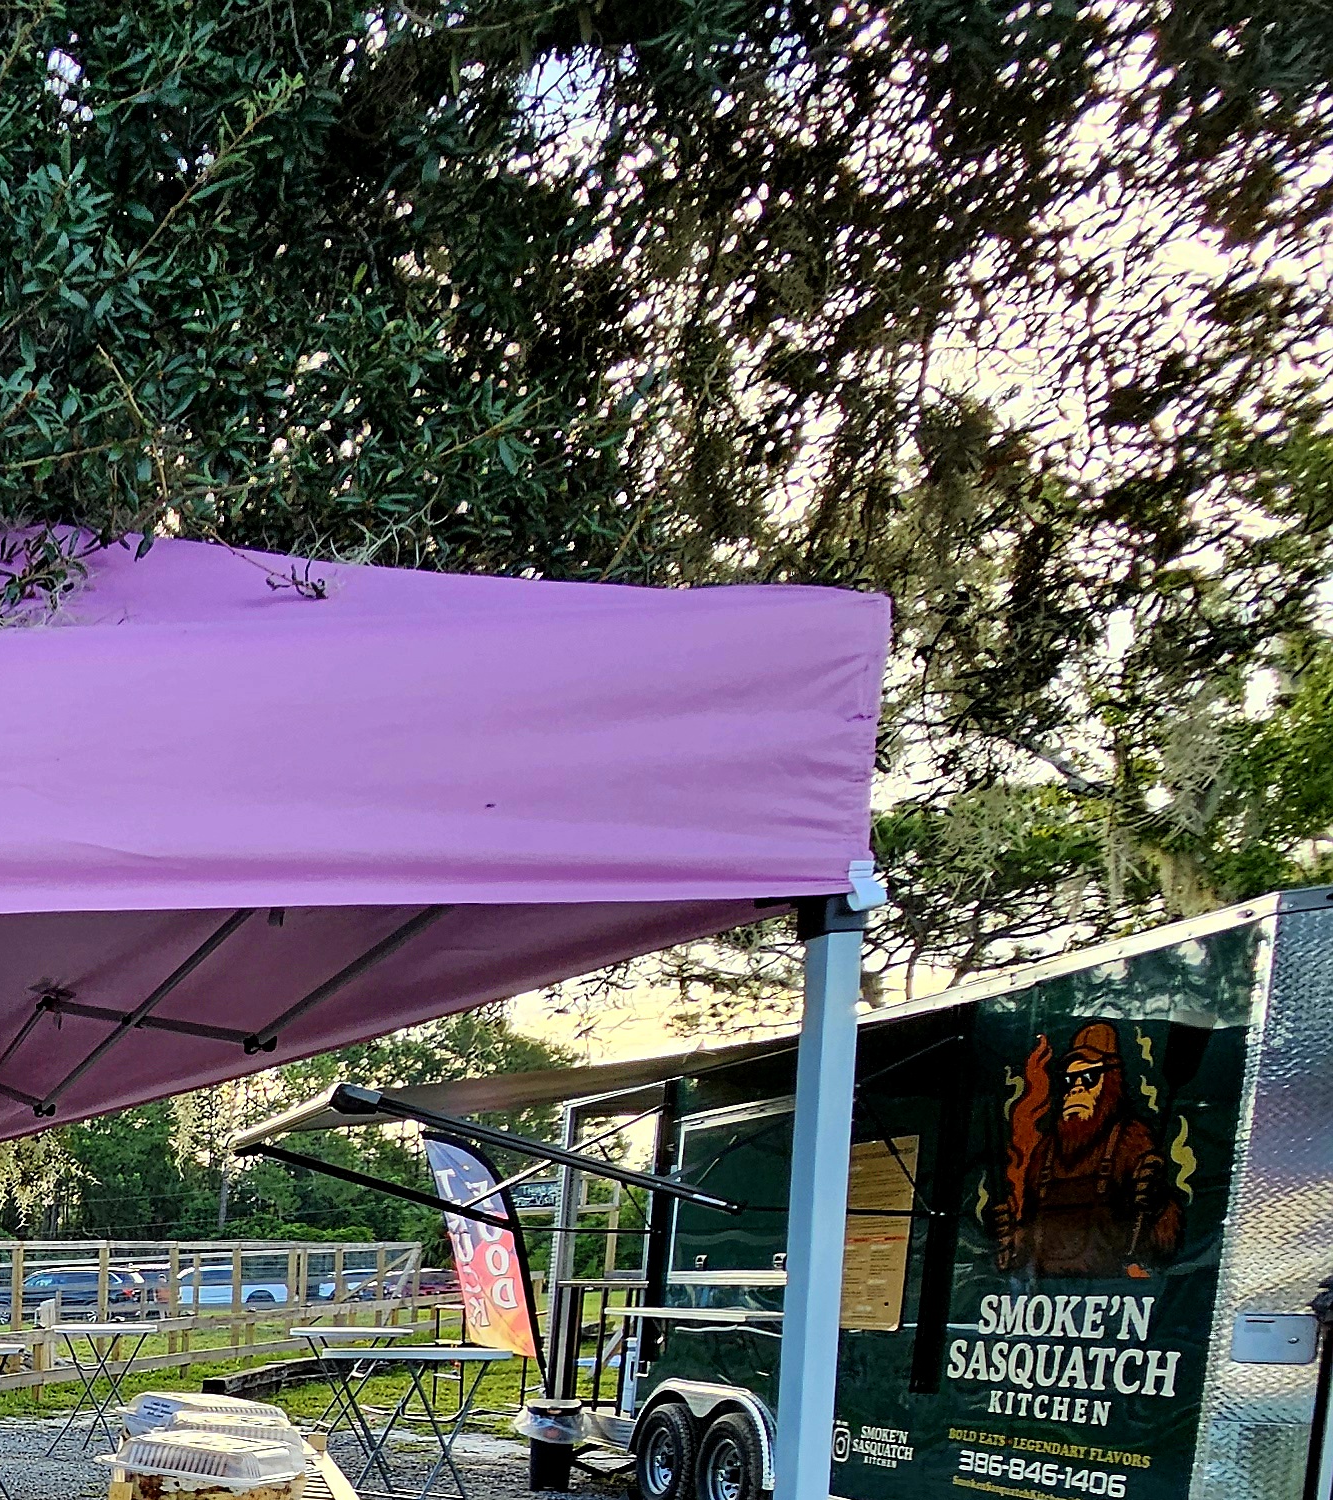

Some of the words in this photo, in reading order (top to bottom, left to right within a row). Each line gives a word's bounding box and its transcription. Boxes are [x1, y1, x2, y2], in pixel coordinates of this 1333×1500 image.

[978, 1295, 1155, 1341] SMOKE'N
[947, 1339, 1181, 1397] SASQUATCH
[988, 1390, 1111, 1427] KITCHEN
[852, 1439, 914, 1460] SASQUATCH
[861, 1426, 909, 1444] SMOKE'N
[948, 1428, 976, 1442] BOLD
[979, 1433, 1006, 1447] EATS
[1013, 1437, 1087, 1459] LEGENDARY
[1089, 1447, 1151, 1468] FLAVORS
[863, 1456, 897, 1469] KITCHEN
[959, 1450, 1127, 1498] 386-846-1406
